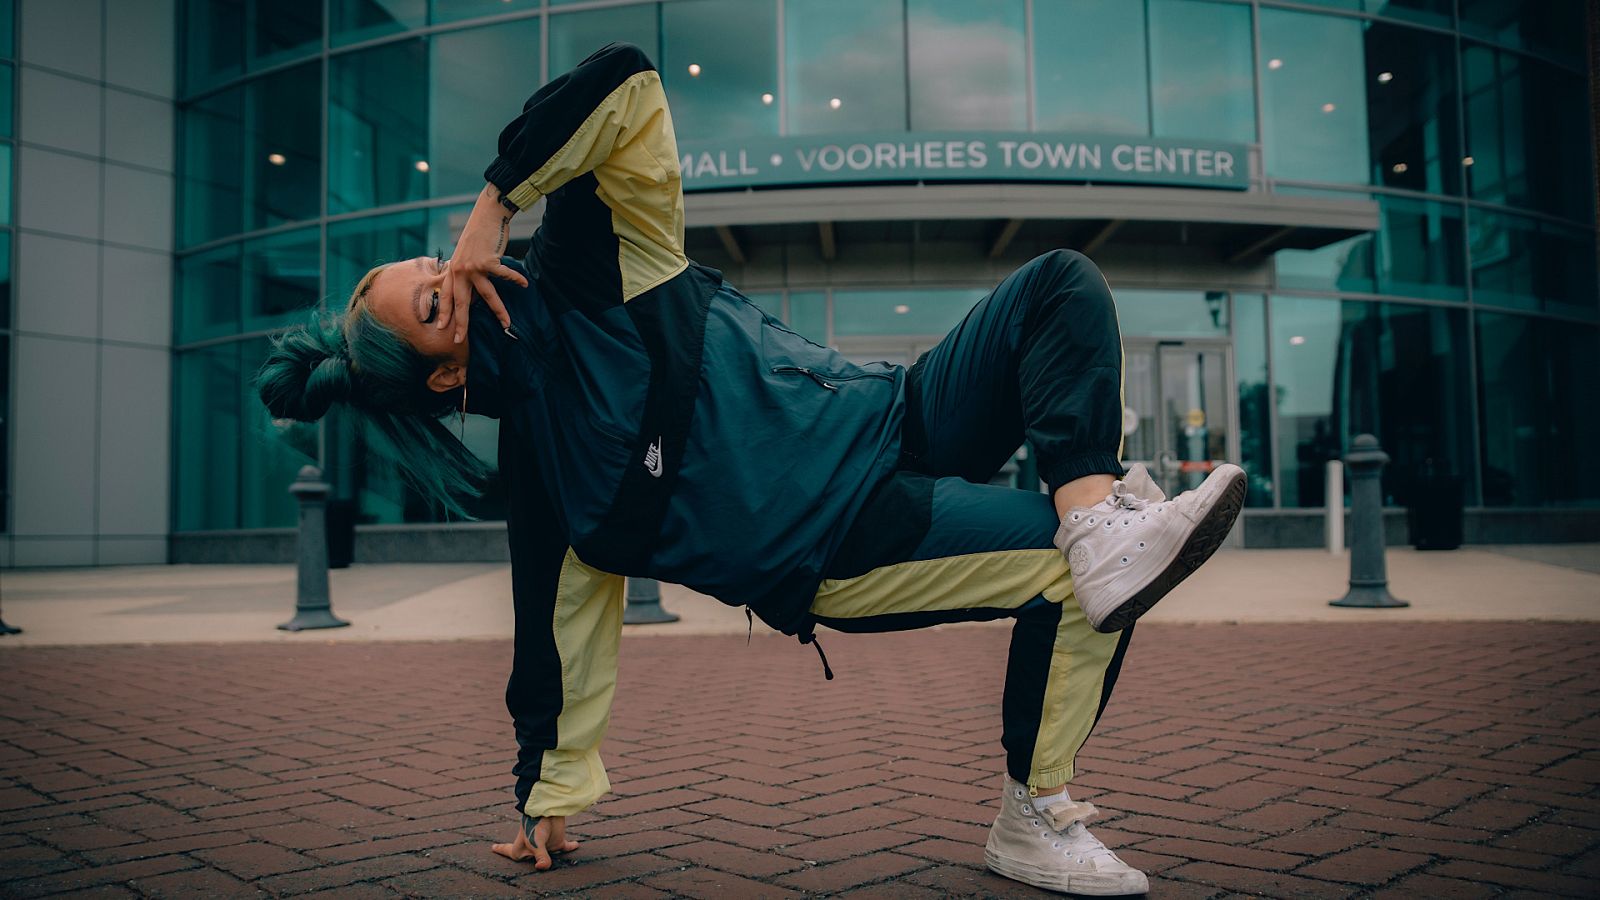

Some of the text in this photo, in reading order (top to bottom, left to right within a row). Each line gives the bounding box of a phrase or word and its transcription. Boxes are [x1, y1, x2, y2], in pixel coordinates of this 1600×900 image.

[796, 140, 988, 172] VOORHEES
[998, 141, 1101, 170] TOWN
[1111, 144, 1235, 177] CENTER
[643, 442, 659, 471] NIKE
